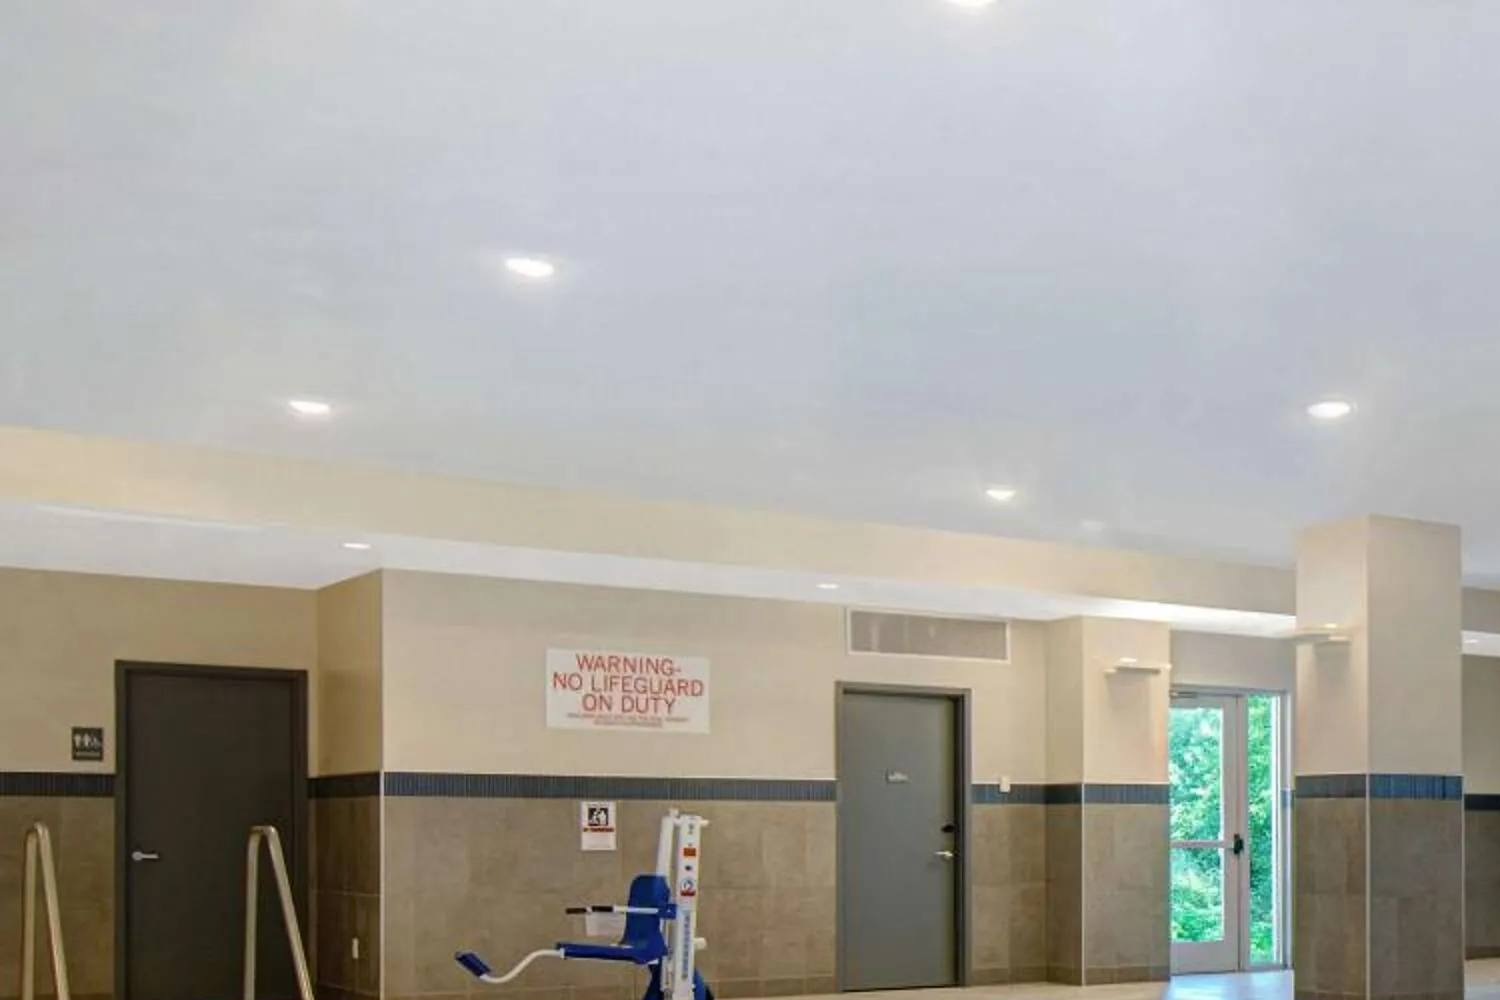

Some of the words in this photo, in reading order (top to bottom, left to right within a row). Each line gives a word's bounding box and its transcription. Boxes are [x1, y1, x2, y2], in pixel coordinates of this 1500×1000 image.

[553, 671, 583, 691] NO
[591, 675, 704, 697] LIFEGUARD
[582, 693, 613, 712] ON
[621, 695, 677, 714] DUTY
